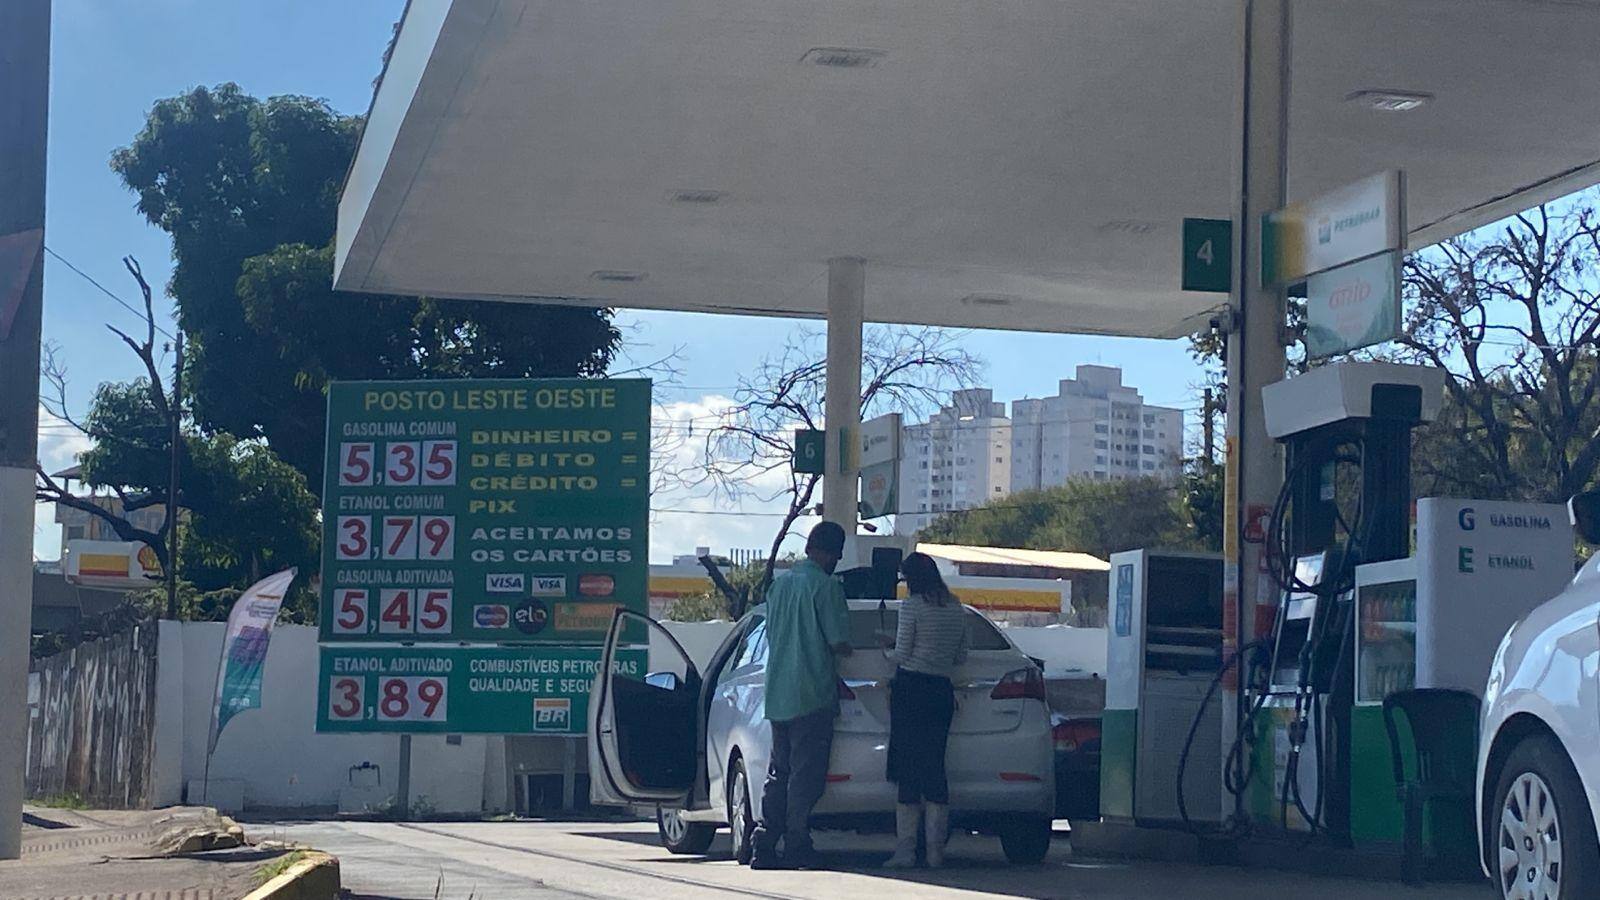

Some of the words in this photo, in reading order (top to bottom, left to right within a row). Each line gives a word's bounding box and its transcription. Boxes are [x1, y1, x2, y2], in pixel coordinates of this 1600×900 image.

[1196, 239, 1214, 266] 4
[364, 390, 445, 411] POSTO
[453, 389, 528, 410] LESTE
[535, 388, 616, 409] OESTE
[342, 421, 406, 436] GASOLINA
[409, 421, 457, 436] COMUM
[471, 430, 612, 445] DINHEIRO
[471, 450, 596, 468] DÉBITO
[805, 442, 816, 460] 6
[341, 443, 454, 484] 5,35
[470, 473, 598, 490] CRÉDITO
[339, 495, 390, 510] ETANOL
[394, 495, 444, 510] COMUM
[469, 499, 517, 513] PIX
[1459, 507, 1475, 531] G
[1489, 512, 1551, 530] GASOLINA
[340, 519, 451, 560] 3,79
[471, 526, 633, 541] ACEITAMOS
[471, 548, 505, 563] OS
[513, 546, 633, 563] CARTÕES
[1458, 545, 1474, 573] E
[336, 570, 393, 584] GASOLINA
[396, 569, 455, 584] ADITIVADA
[490, 577, 522, 588] VISA
[538, 579, 561, 589] VISA
[337, 591, 449, 632] 5,45
[334, 657, 386, 672] ETANOL
[390, 656, 453, 672] ADITIVADO
[470, 655, 560, 673] COMBUSTÍVEIS
[562, 660, 638, 674] PETRORAS
[469, 678, 540, 692] QUALIDADE
[546, 679, 554, 693] E
[332, 679, 444, 719] 3,89
[538, 710, 567, 723] BR
